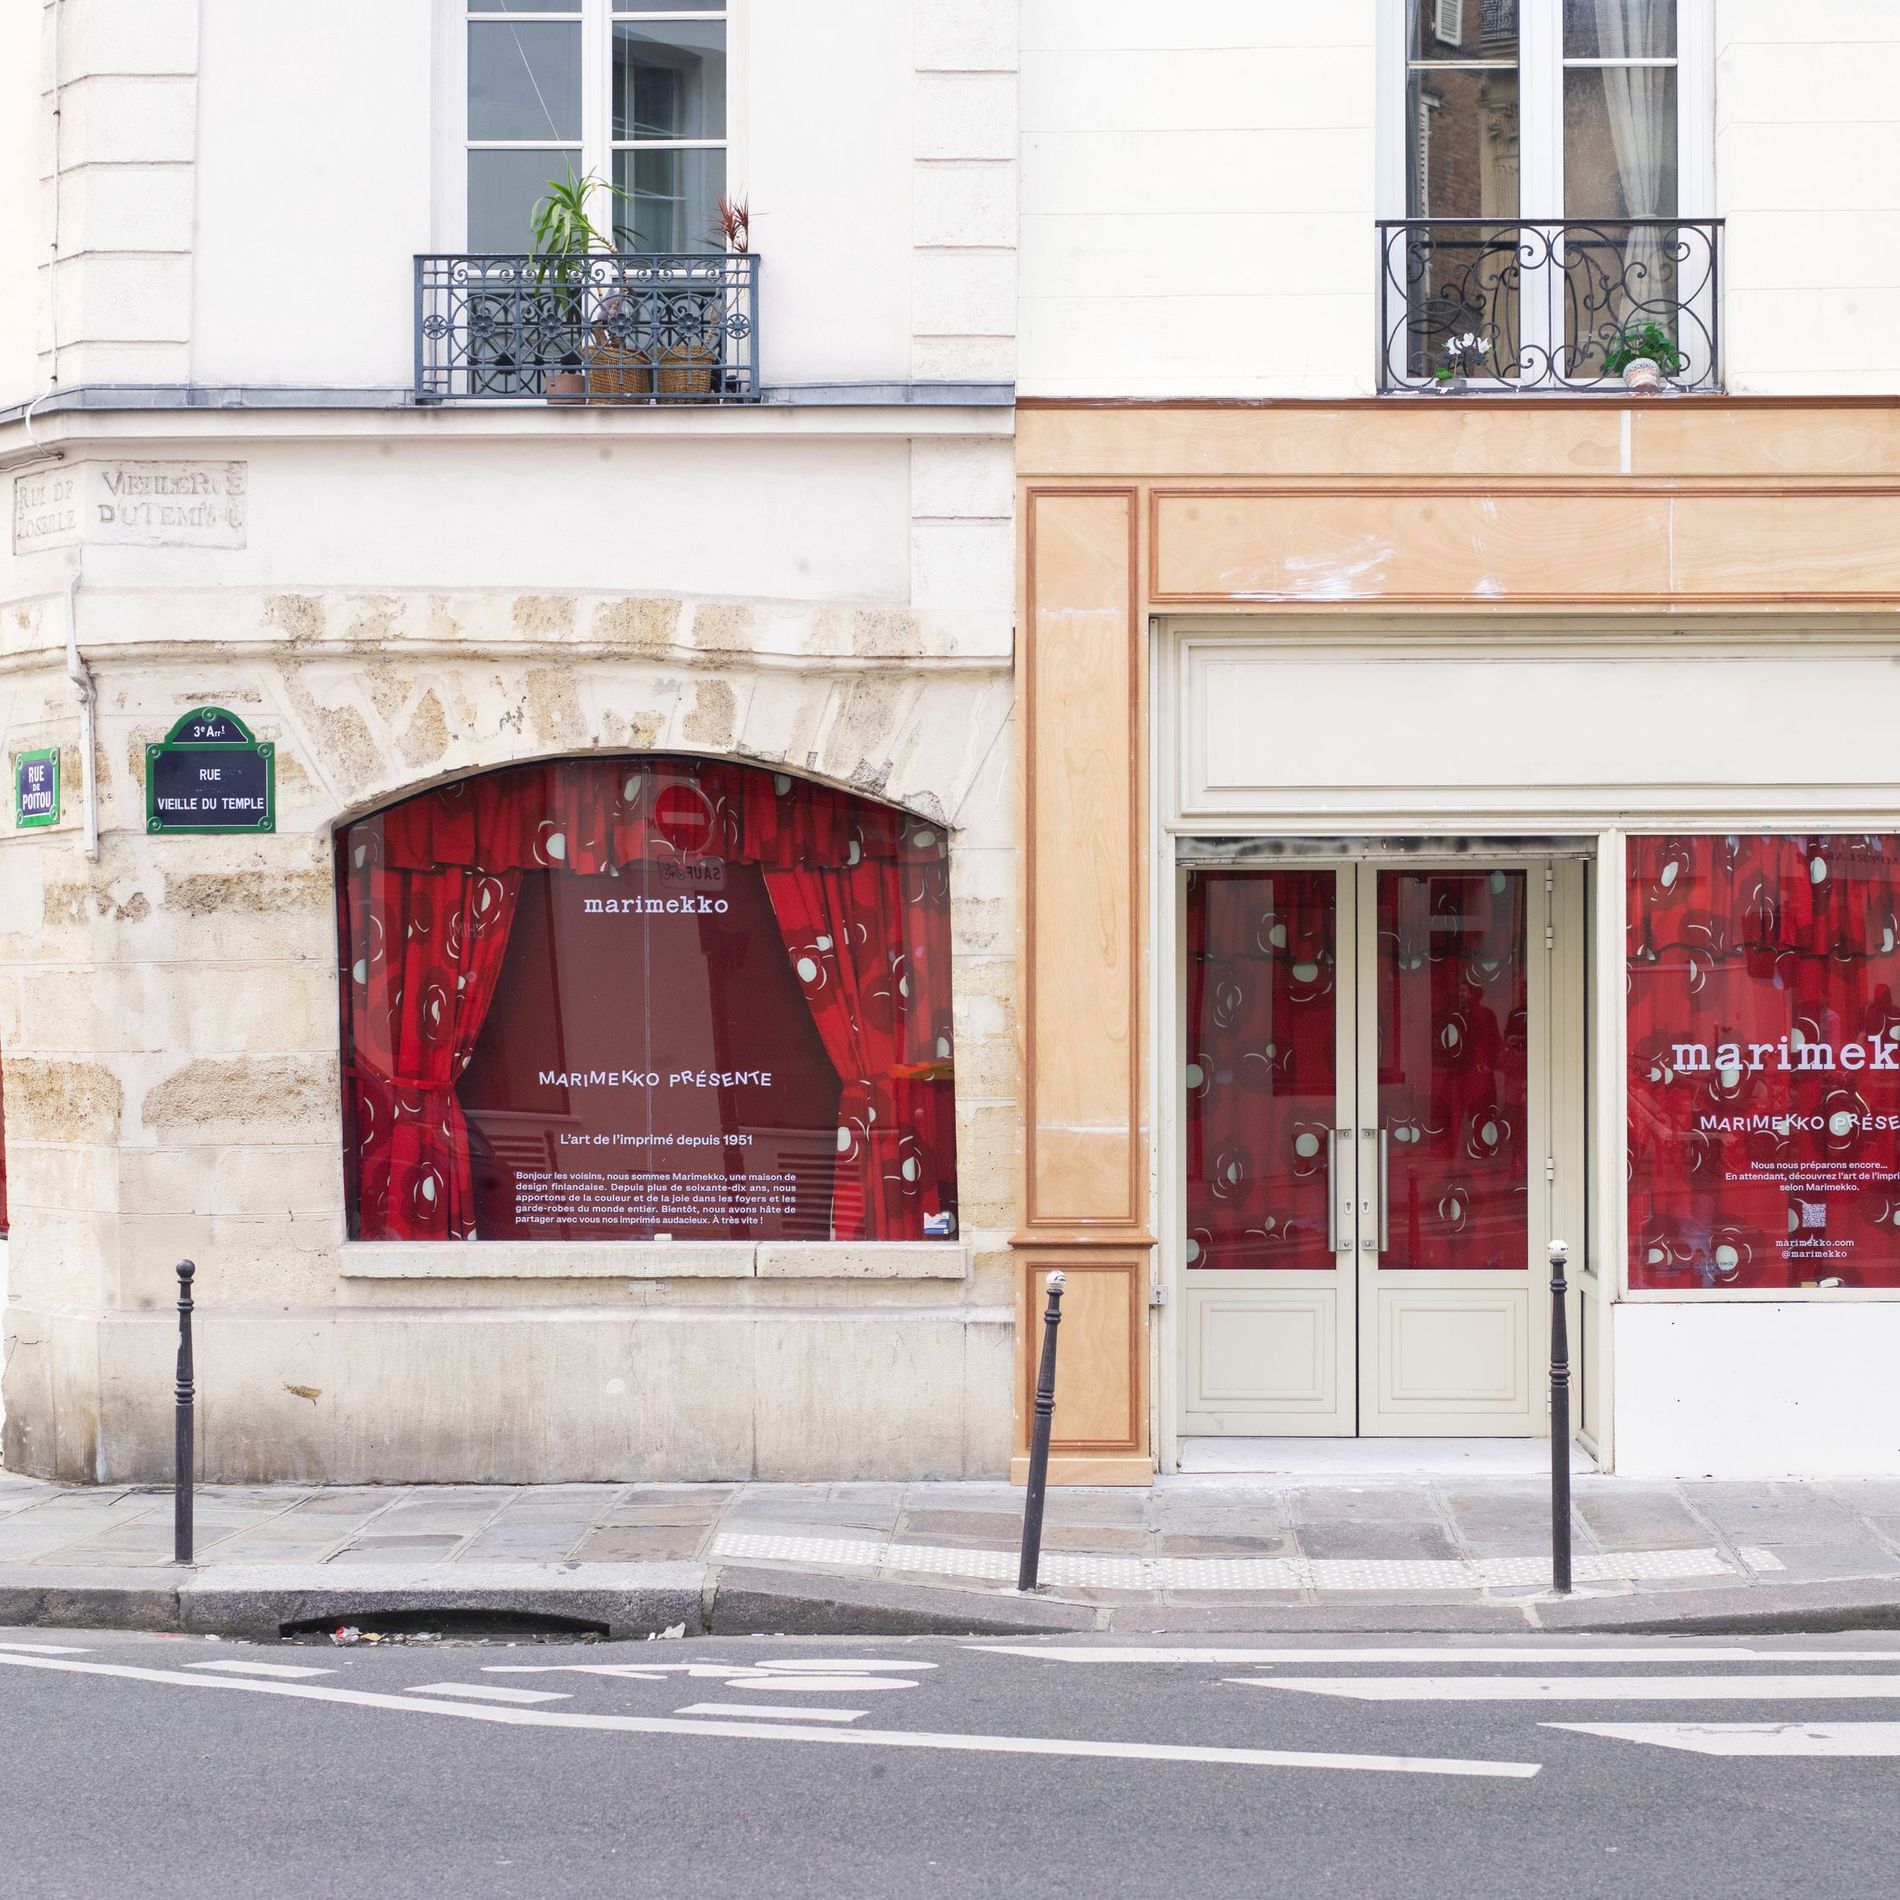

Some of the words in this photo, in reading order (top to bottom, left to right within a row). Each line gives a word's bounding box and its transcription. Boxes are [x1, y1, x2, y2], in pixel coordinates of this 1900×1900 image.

[28, 764, 45, 783] RUE
[199, 768, 221, 781] RUE
[32, 783, 41, 792] DE
[22, 790, 52, 811] POITOU
[157, 797, 198, 810] VIEILLE
[201, 797, 217, 810] DU
[221, 797, 265, 810] TEMPLE
[584, 895, 730, 914] marimekko
[1671, 1035, 1900, 1071] marimek
[538, 1069, 660, 1088] MARIMEKKO
[669, 1069, 773, 1088] PRÉSENTE
[1700, 1113, 1825, 1132] MARIMEKKO
[560, 1133, 591, 1145] L’art
[593, 1134, 610, 1145] de
[612, 1133, 674, 1148] l’imprimé
[676, 1134, 720, 1148] depuis
[723, 1134, 752, 1146] 1951
[1751, 1161, 1775, 1170] Nous
[1776, 1162, 1799, 1170] nous
[1800, 1160, 1847, 1171] préparons
[1848, 1161, 1888, 1170] encore...
[516, 1171, 553, 1181] Bonjour
[554, 1172, 568, 1180] les
[569, 1171, 605, 1181] voisins,
[606, 1173, 630, 1181] nous
[672, 1172, 728, 1182] Marimekko,
[748, 1173, 783, 1181] maison
[784, 1173, 796, 1181] de
[1725, 1172, 1738, 1180] En
[1739, 1172, 1787, 1181] attendant,
[1788, 1171, 1836, 1180] découvrez
[1838, 1172, 1857, 1180] l’art
[1858, 1172, 1870, 1180] de
[515, 1182, 548, 1192] design
[551, 1182, 607, 1191] finlandaise.
[610, 1183, 644, 1193] Depuis
[647, 1183, 668, 1192] plus
[670, 1183, 683, 1192] de
[685, 1183, 747, 1192] soixante-dix
[749, 1185, 770, 1193] ans,
[1779, 1183, 1804, 1191] selon
[1806, 1183, 1860, 1191] Marimekko.
[515, 1194, 566, 1203] apportons
[568, 1193, 581, 1202] de
[583, 1193, 592, 1202] la
[594, 1194, 631, 1202] couleur
[646, 1194, 659, 1202] de
[660, 1194, 670, 1202] la
[671, 1194, 690, 1204] joie
[692, 1194, 716, 1203] dans
[718, 1194, 733, 1203] les
[735, 1194, 767, 1205] foyers
[768, 1195, 780, 1203] et
[781, 1195, 796, 1203] les
[515, 1204, 575, 1214] garde-robes
[577, 1204, 590, 1213] du
[592, 1204, 625, 1213] monde
[627, 1204, 659, 1213] entier.
[661, 1204, 700, 1214] Bientôt,
[702, 1206, 726, 1214] nous
[728, 1206, 757, 1214] avons
[759, 1205, 782, 1214] hâte
[783, 1205, 796, 1214] de
[515, 1215, 555, 1225] partager
[556, 1216, 578, 1224] avec
[619, 1215, 661, 1225] imprimés
[662, 1216, 711, 1224] audacieux.
[712, 1214, 720, 1224] À
[721, 1215, 740, 1224] très
[740, 1216, 759, 1225] vite
[1775, 1237, 1855, 1247] marimekko.com
[1781, 1250, 1848, 1259] @marimekko
